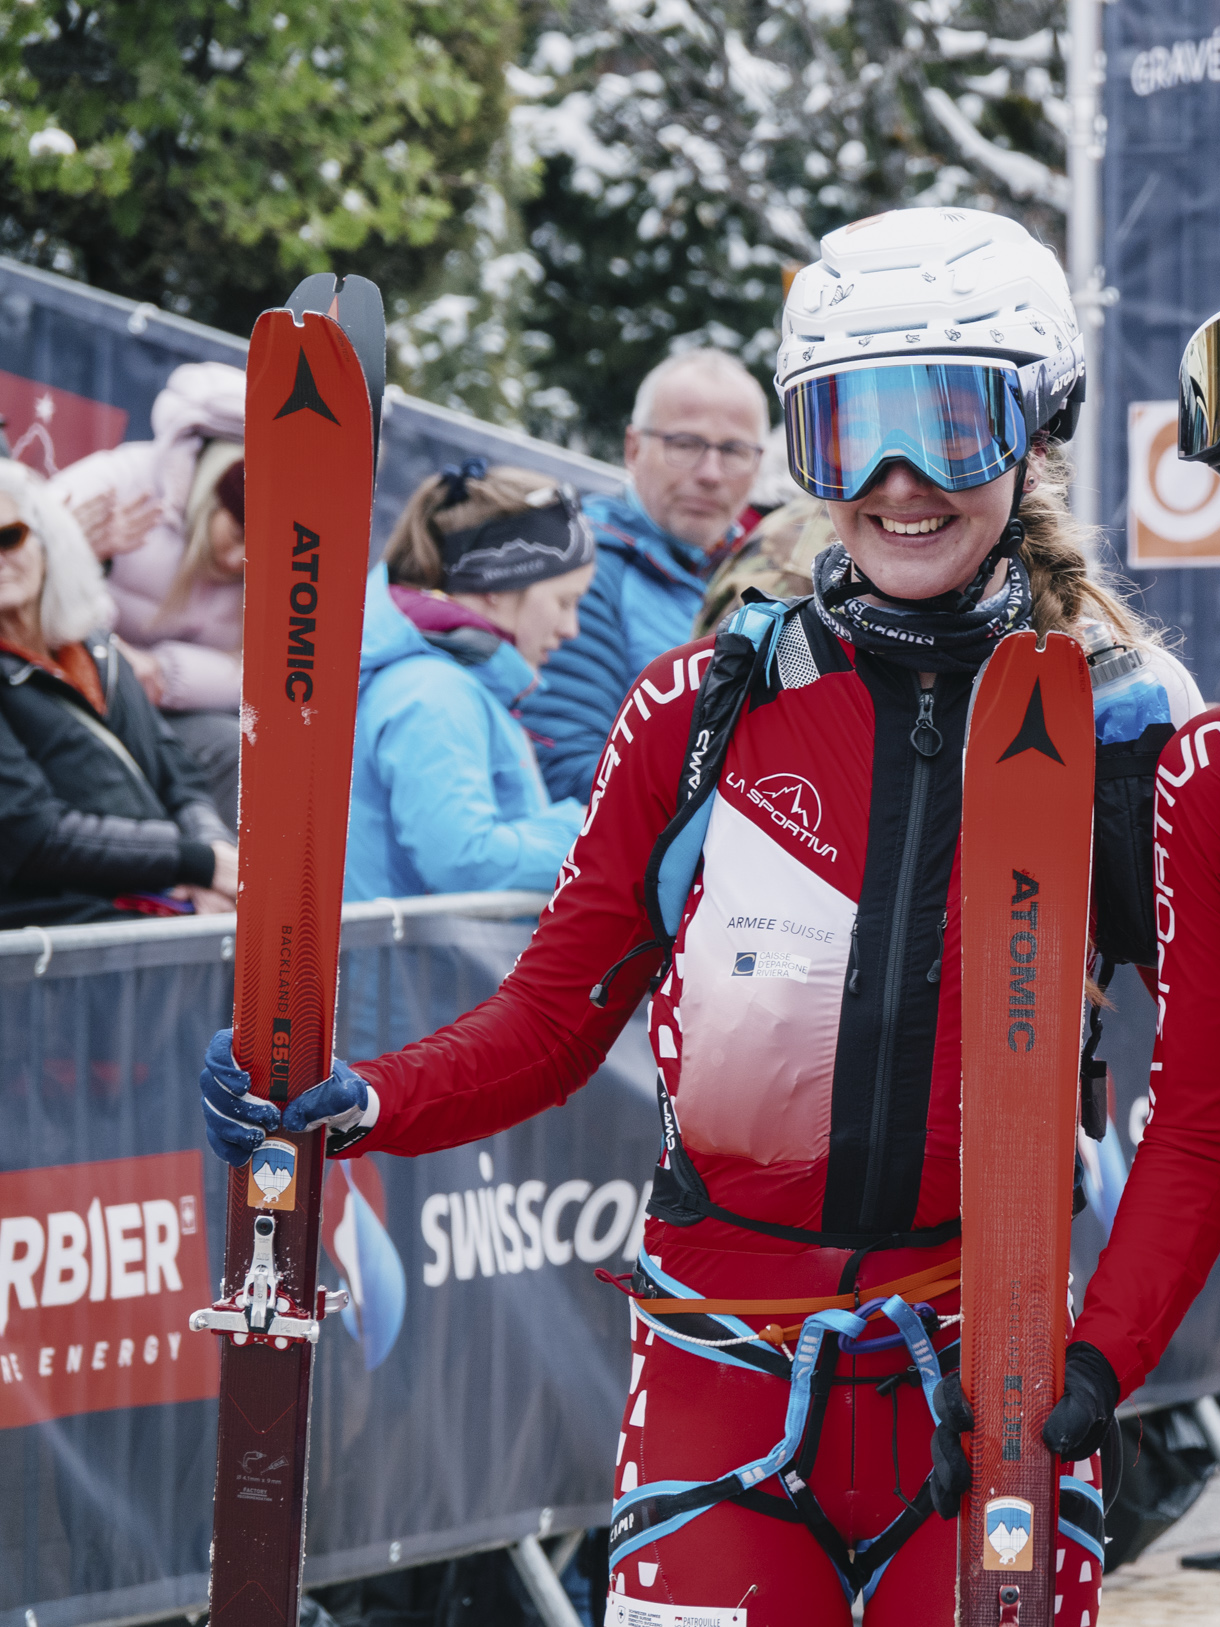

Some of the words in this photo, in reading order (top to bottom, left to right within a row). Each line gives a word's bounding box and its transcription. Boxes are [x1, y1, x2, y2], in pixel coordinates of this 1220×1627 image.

[286, 521, 320, 703] ATOMIC
[725, 771, 746, 794] LA
[746, 787, 838, 863] SPORTIVA
[727, 917, 777, 930] ARMEE
[780, 920, 835, 944] SUISSE
[759, 951, 792, 961] CAISSE
[278, 925, 293, 1014] BACKLAND
[755, 969, 790, 977] RIVIERA
[1008, 868, 1038, 1053] ATOMIC
[271, 1031, 290, 1087] 65UL
[38, 1331, 182, 1377] ENERGY
[683, 1616, 721, 1627] PATROUILLE
